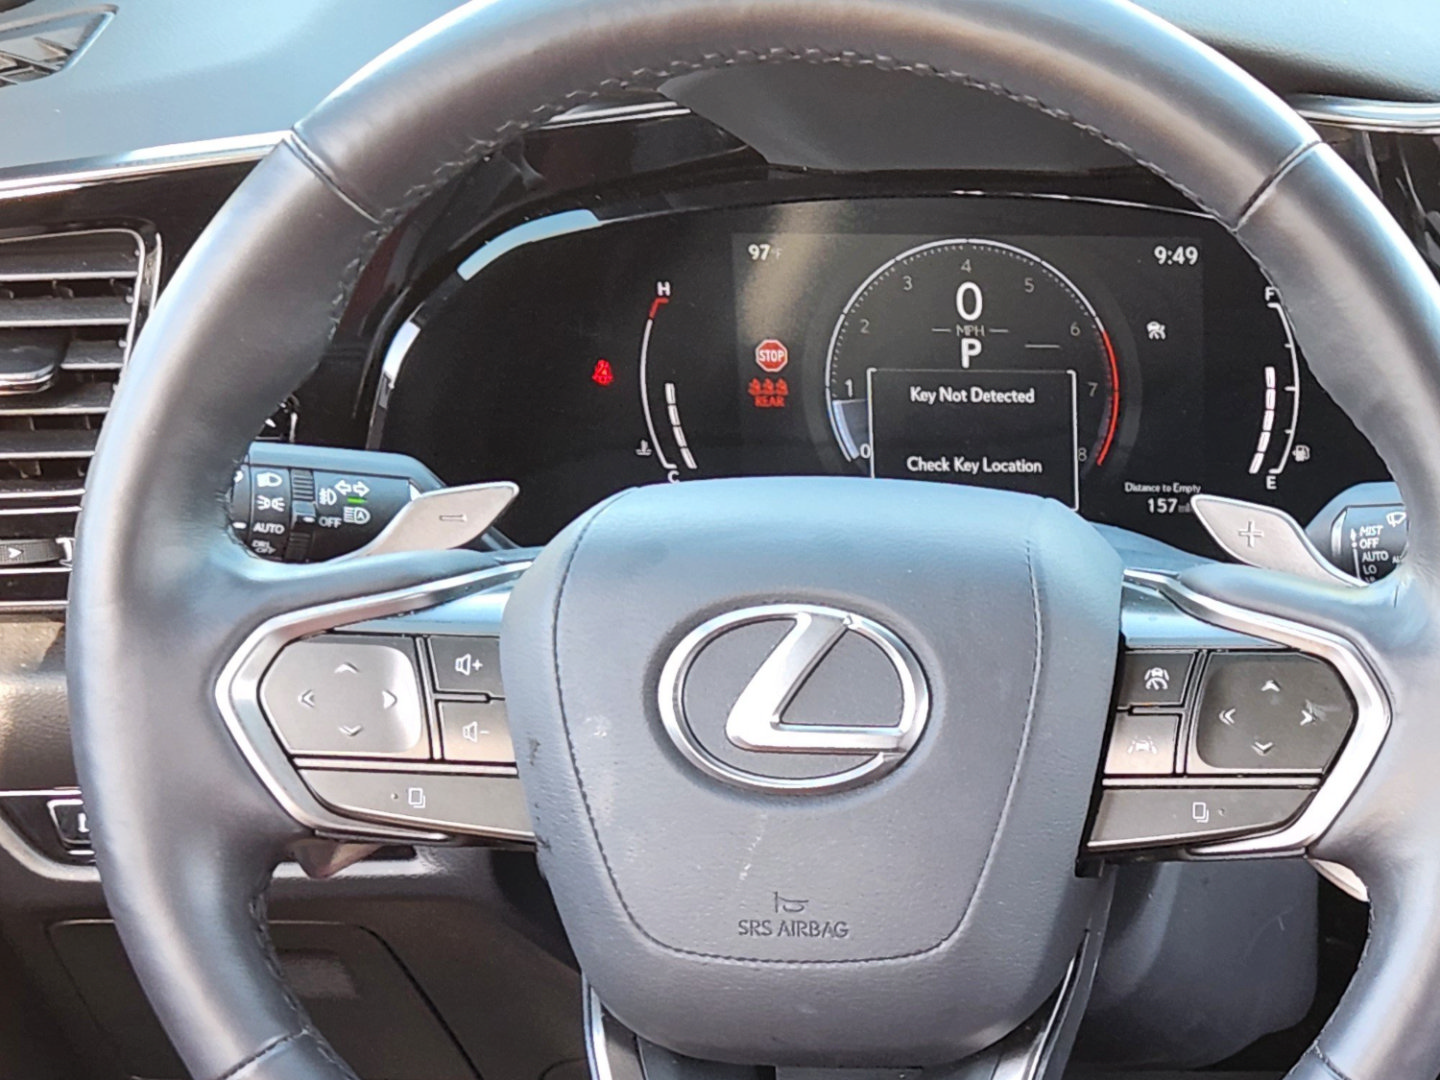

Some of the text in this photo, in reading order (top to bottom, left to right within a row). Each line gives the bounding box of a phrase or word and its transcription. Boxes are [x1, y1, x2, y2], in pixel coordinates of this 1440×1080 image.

[748, 243, 771, 260] 97
[1154, 246, 1199, 265] 9:49
[960, 258, 972, 273] 4
[657, 280, 672, 297] H
[903, 275, 914, 292] 3
[1024, 277, 1036, 294] 5
[1264, 286, 1275, 301] F
[955, 281, 984, 322] 0
[860, 319, 870, 334] 2
[956, 325, 985, 337] MPH
[1070, 322, 1081, 337] 6
[758, 349, 785, 364] STOP
[961, 338, 982, 369] P
[844, 379, 853, 397] 1
[910, 386, 1036, 404] Key Not Detected
[1087, 382, 1098, 398] 7
[860, 443, 871, 459] 0
[1078, 449, 1088, 462] 8
[906, 456, 1043, 474] Check Key Location
[1124, 481, 1201, 494] Distance to Empty
[1265, 475, 1277, 490] E
[1148, 498, 1178, 514] 157
[253, 523, 285, 535] AUTO
[318, 516, 342, 529] OFF
[1360, 525, 1384, 537] MIST
[1360, 538, 1380, 549] OFF
[1362, 551, 1389, 562] AUTO
[1363, 565, 1377, 575] LO
[738, 920, 849, 938] SRS AIRBAG
